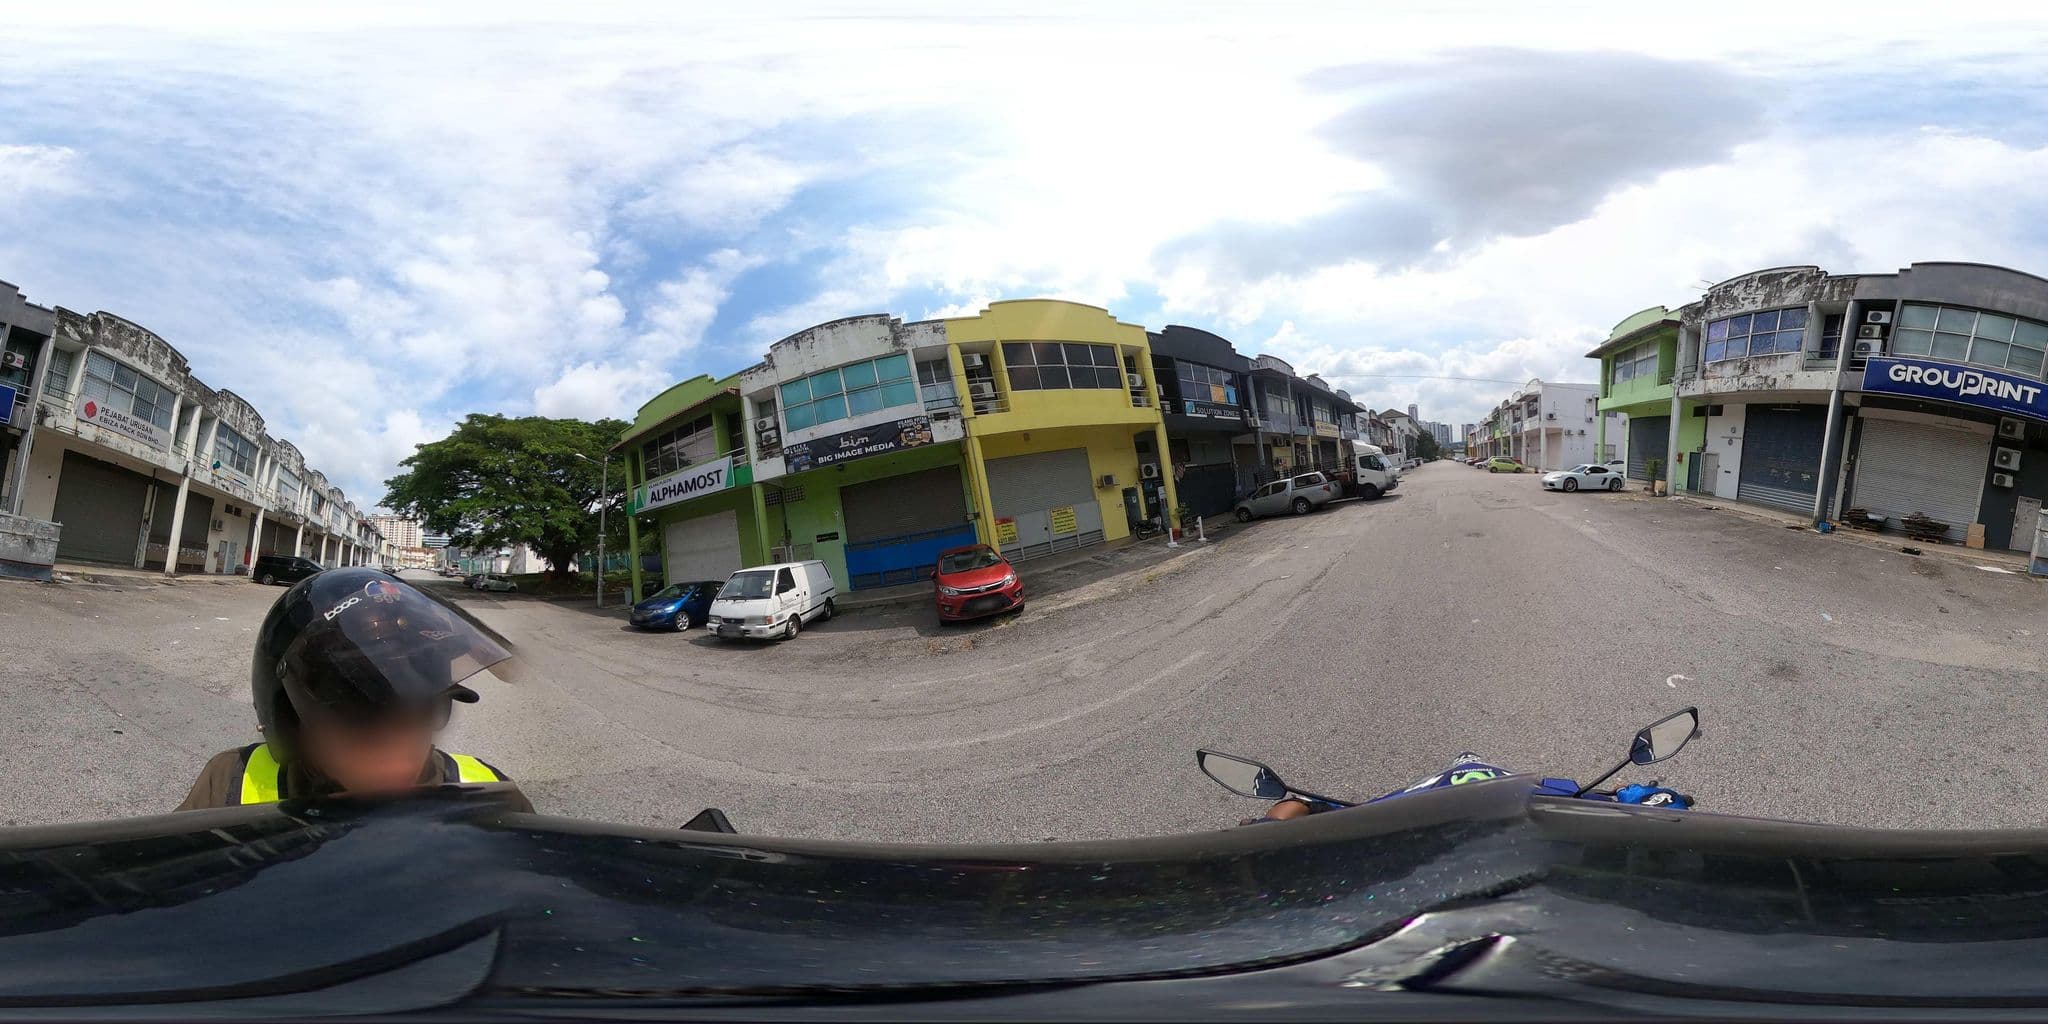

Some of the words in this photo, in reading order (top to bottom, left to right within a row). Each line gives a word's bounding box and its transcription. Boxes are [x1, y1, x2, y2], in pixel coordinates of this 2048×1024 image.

[1888, 363, 2041, 404] GROUPRINT
[99, 415, 119, 429] EBIZA
[119, 424, 135, 436] PACK
[100, 406, 129, 422] PEJABAT
[129, 419, 154, 435] URUSAN
[818, 454, 833, 464] BIG
[834, 447, 863, 460] IMAGE
[864, 441, 895, 453] MEDIA
[650, 469, 723, 503] ALPHAMOST
